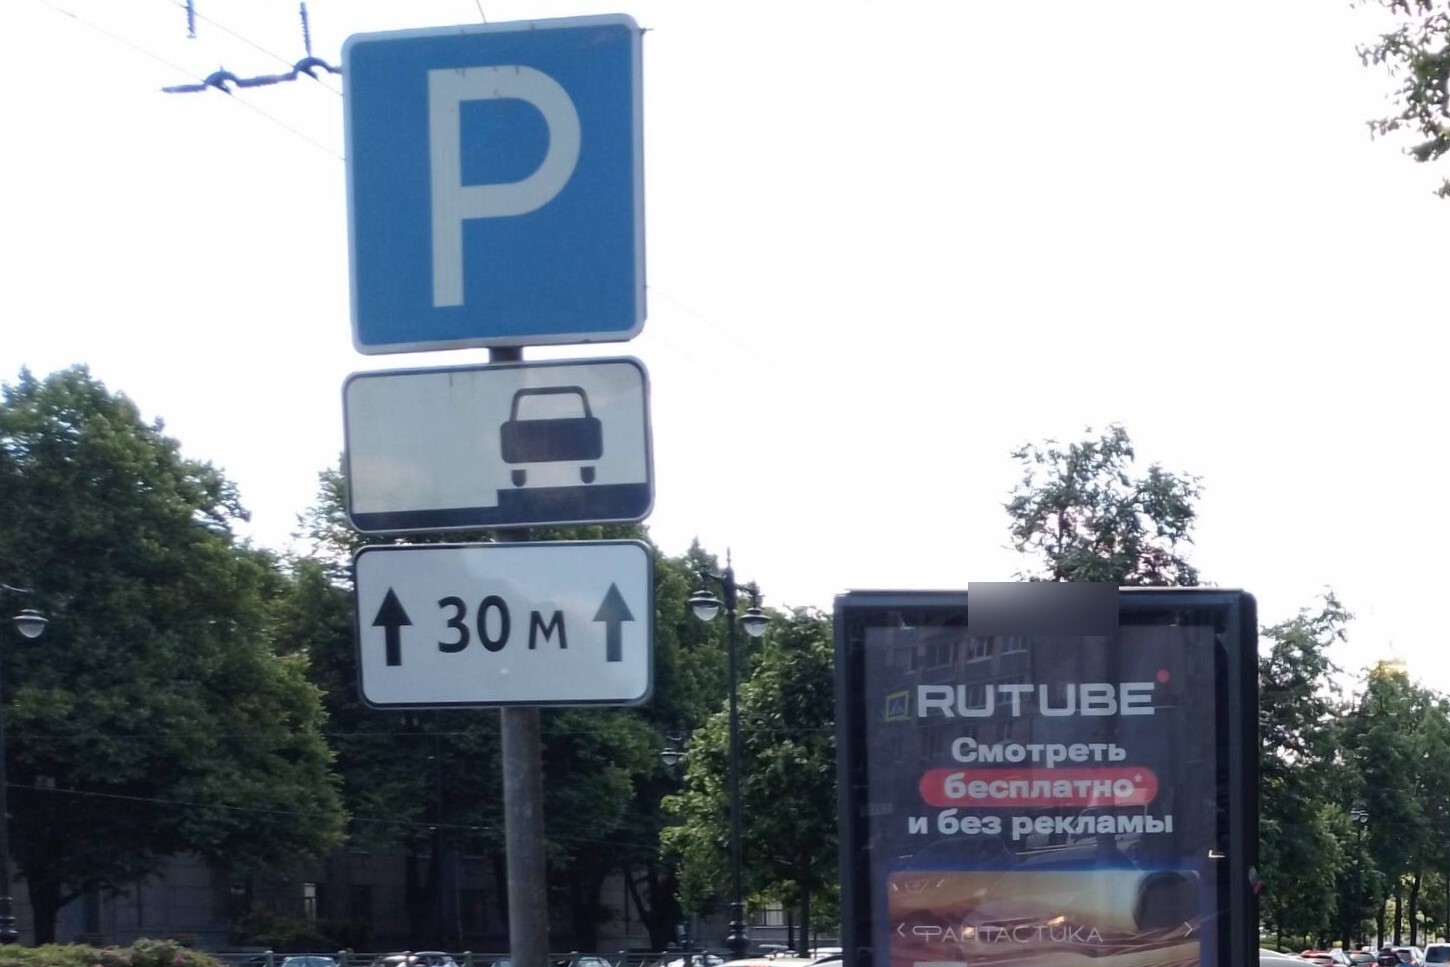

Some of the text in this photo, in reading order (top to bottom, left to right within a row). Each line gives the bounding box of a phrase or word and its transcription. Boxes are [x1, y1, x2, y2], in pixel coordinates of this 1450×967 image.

[427, 65, 581, 308] P
[437, 594, 511, 653] 30
[917, 682, 1155, 718] RUTUBE
[951, 736, 1127, 768] Смотреть
[908, 808, 1174, 841] и без рекламы
